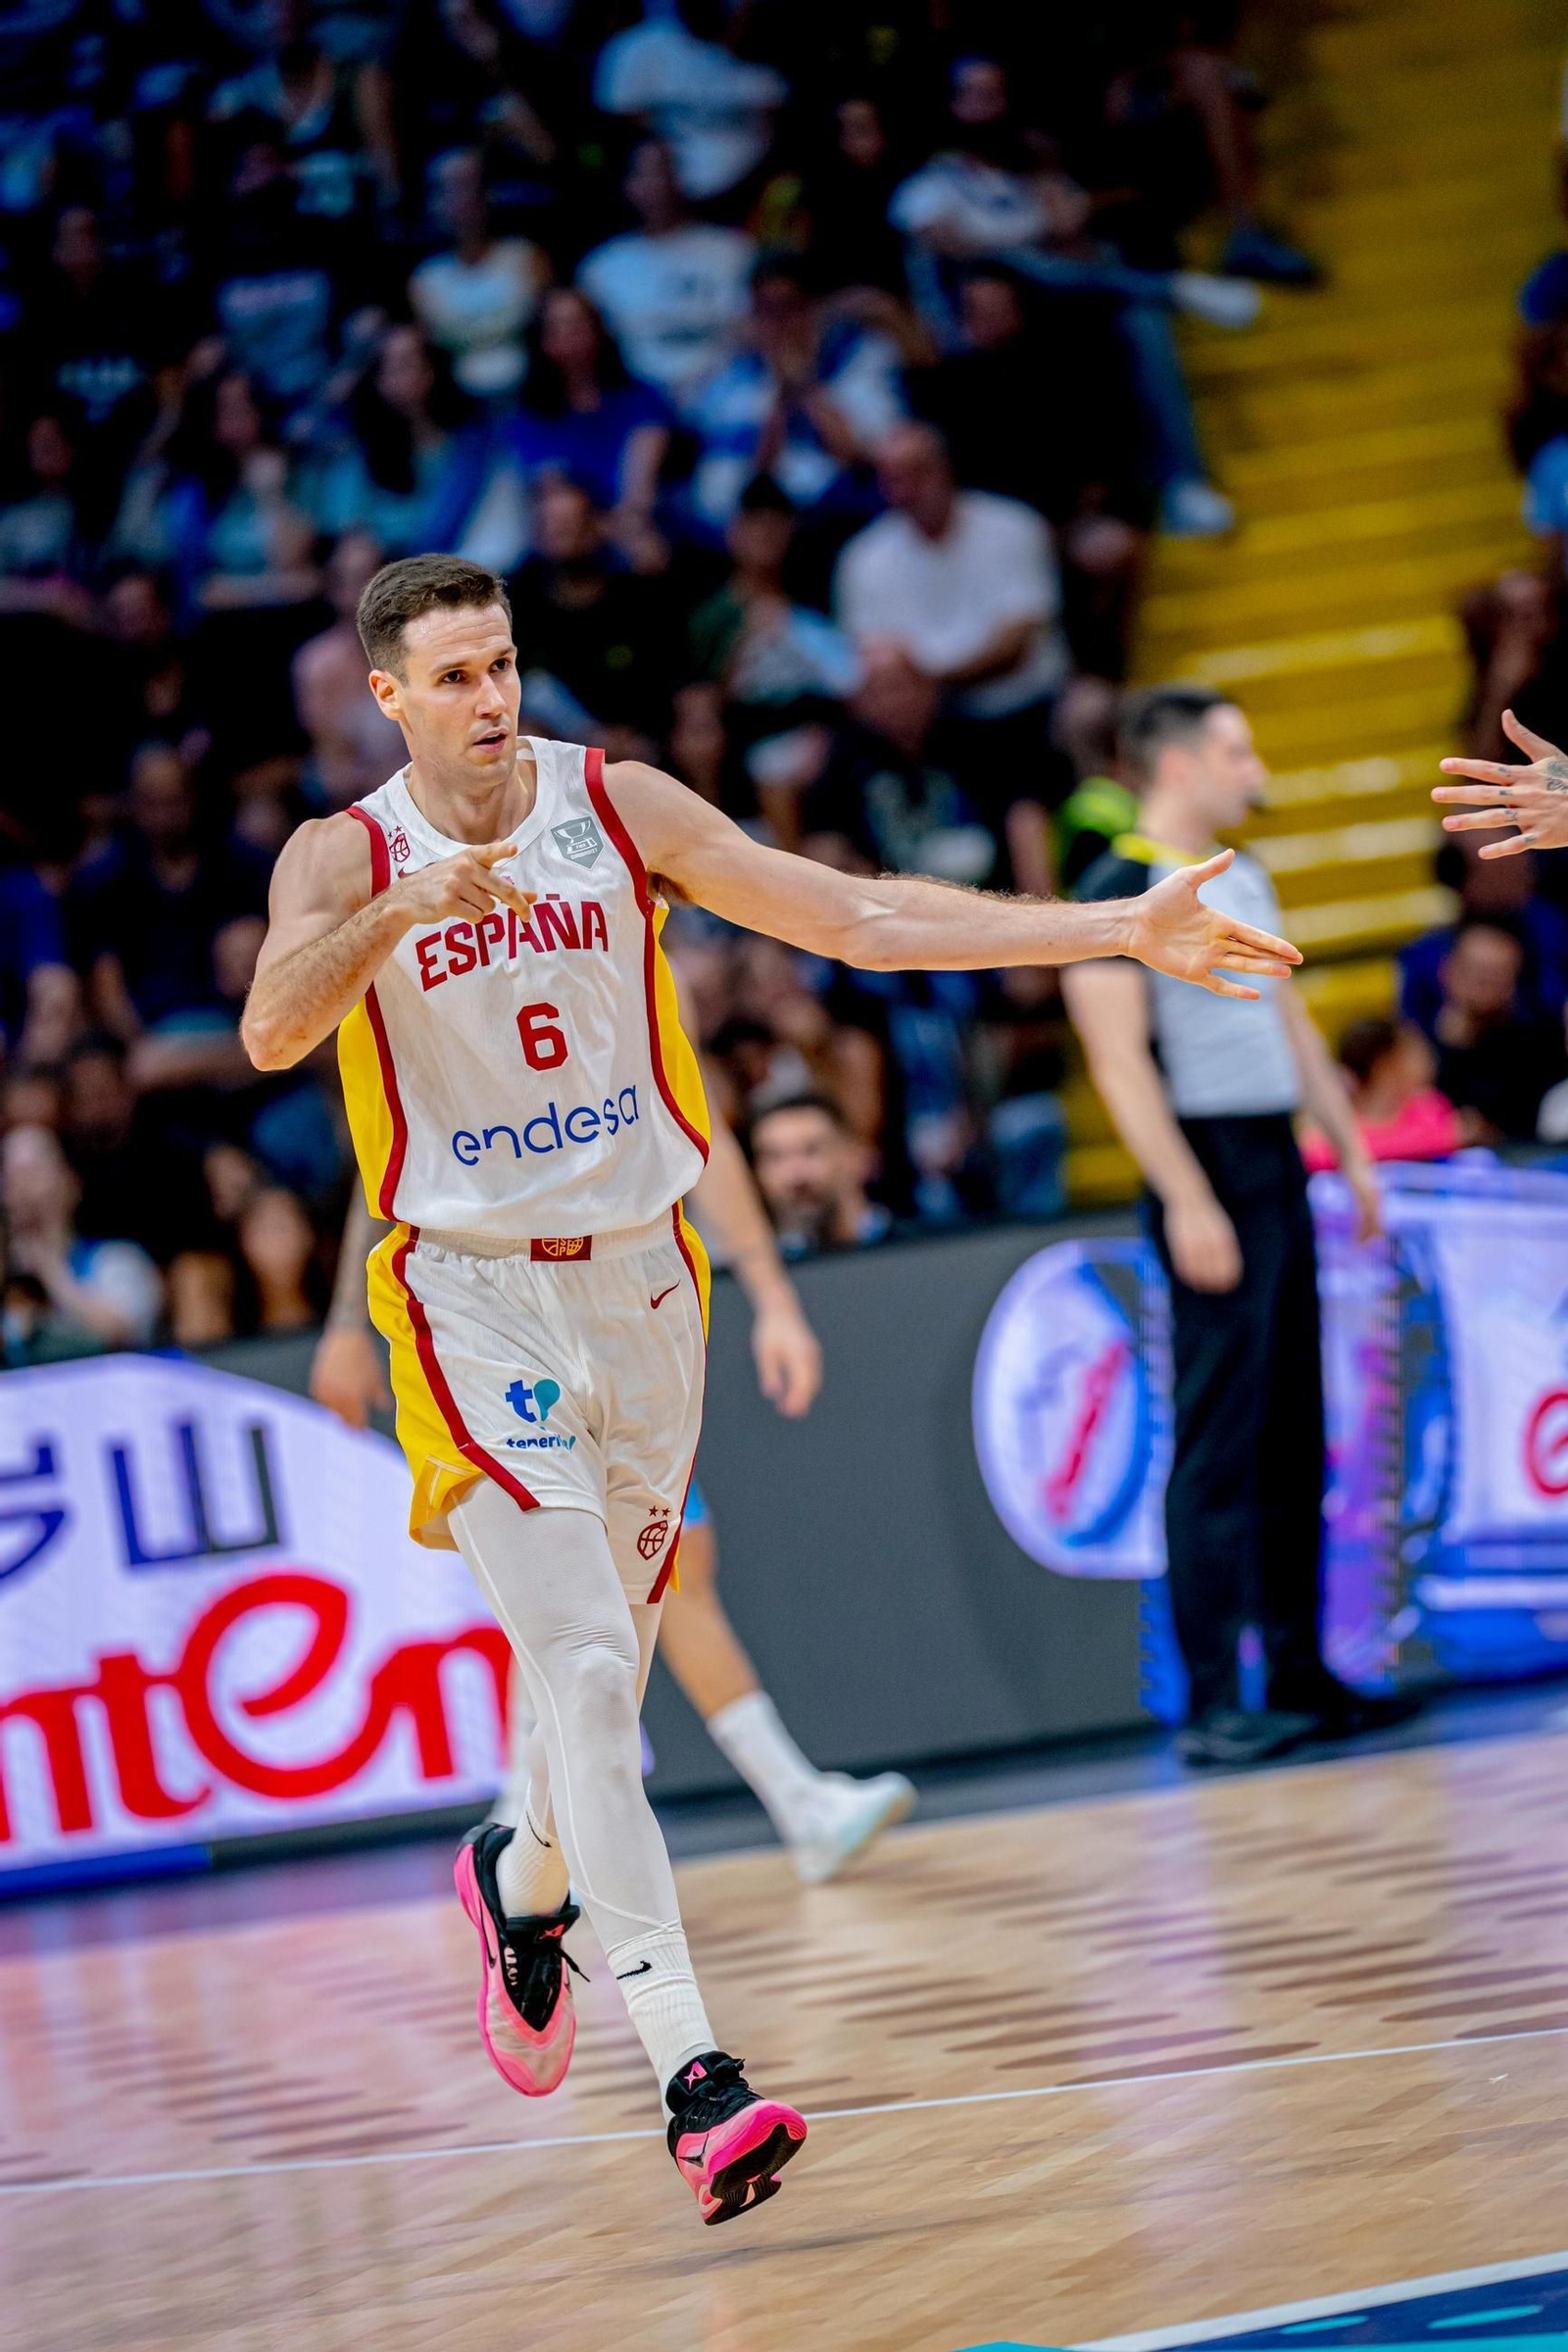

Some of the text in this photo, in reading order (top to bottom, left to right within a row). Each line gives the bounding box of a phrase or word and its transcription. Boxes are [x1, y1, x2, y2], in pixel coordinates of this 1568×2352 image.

[415, 893, 609, 993] ESPAÑA
[516, 1002, 568, 1071] 6
[452, 1085, 639, 1166] endesa
